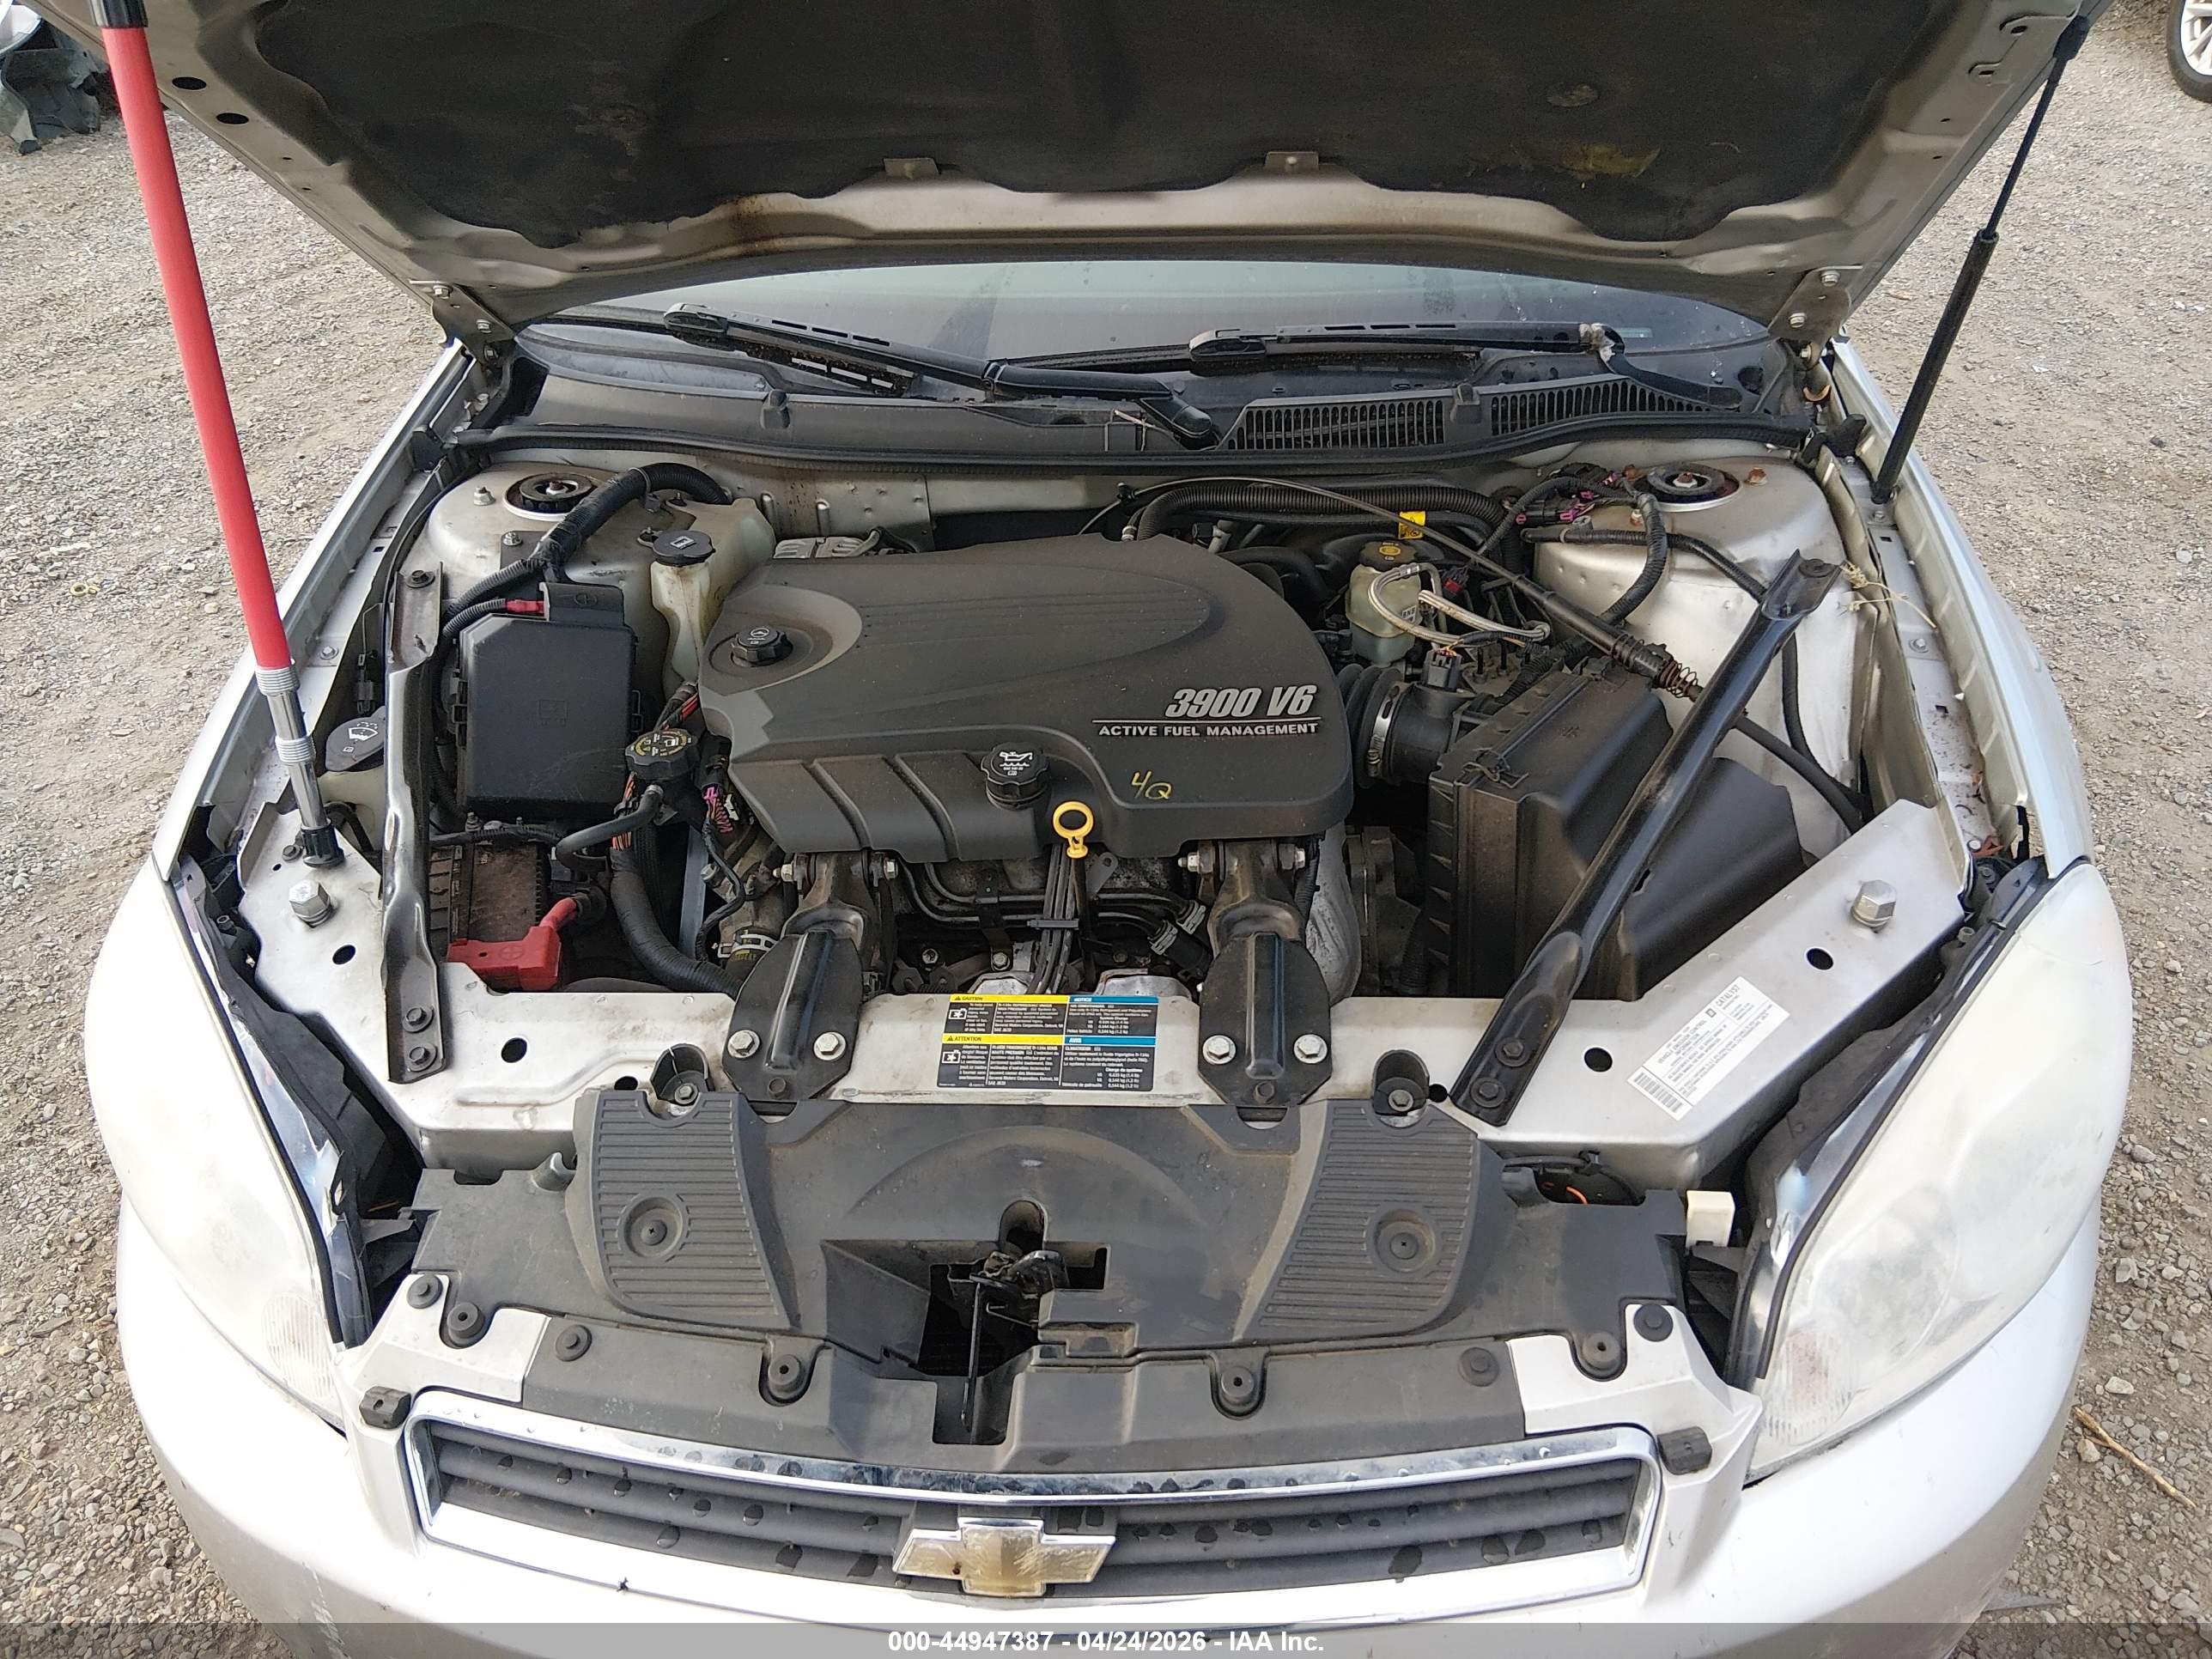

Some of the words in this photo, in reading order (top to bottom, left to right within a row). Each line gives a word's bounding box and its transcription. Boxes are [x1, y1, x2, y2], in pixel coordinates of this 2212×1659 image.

[1165, 687, 1262, 718] 3900
[1267, 684, 1318, 716] V6
[1098, 726, 1158, 736] ACTIVE
[1164, 726, 1200, 736] FUEL
[1206, 723, 1319, 736] MANAGEMENT
